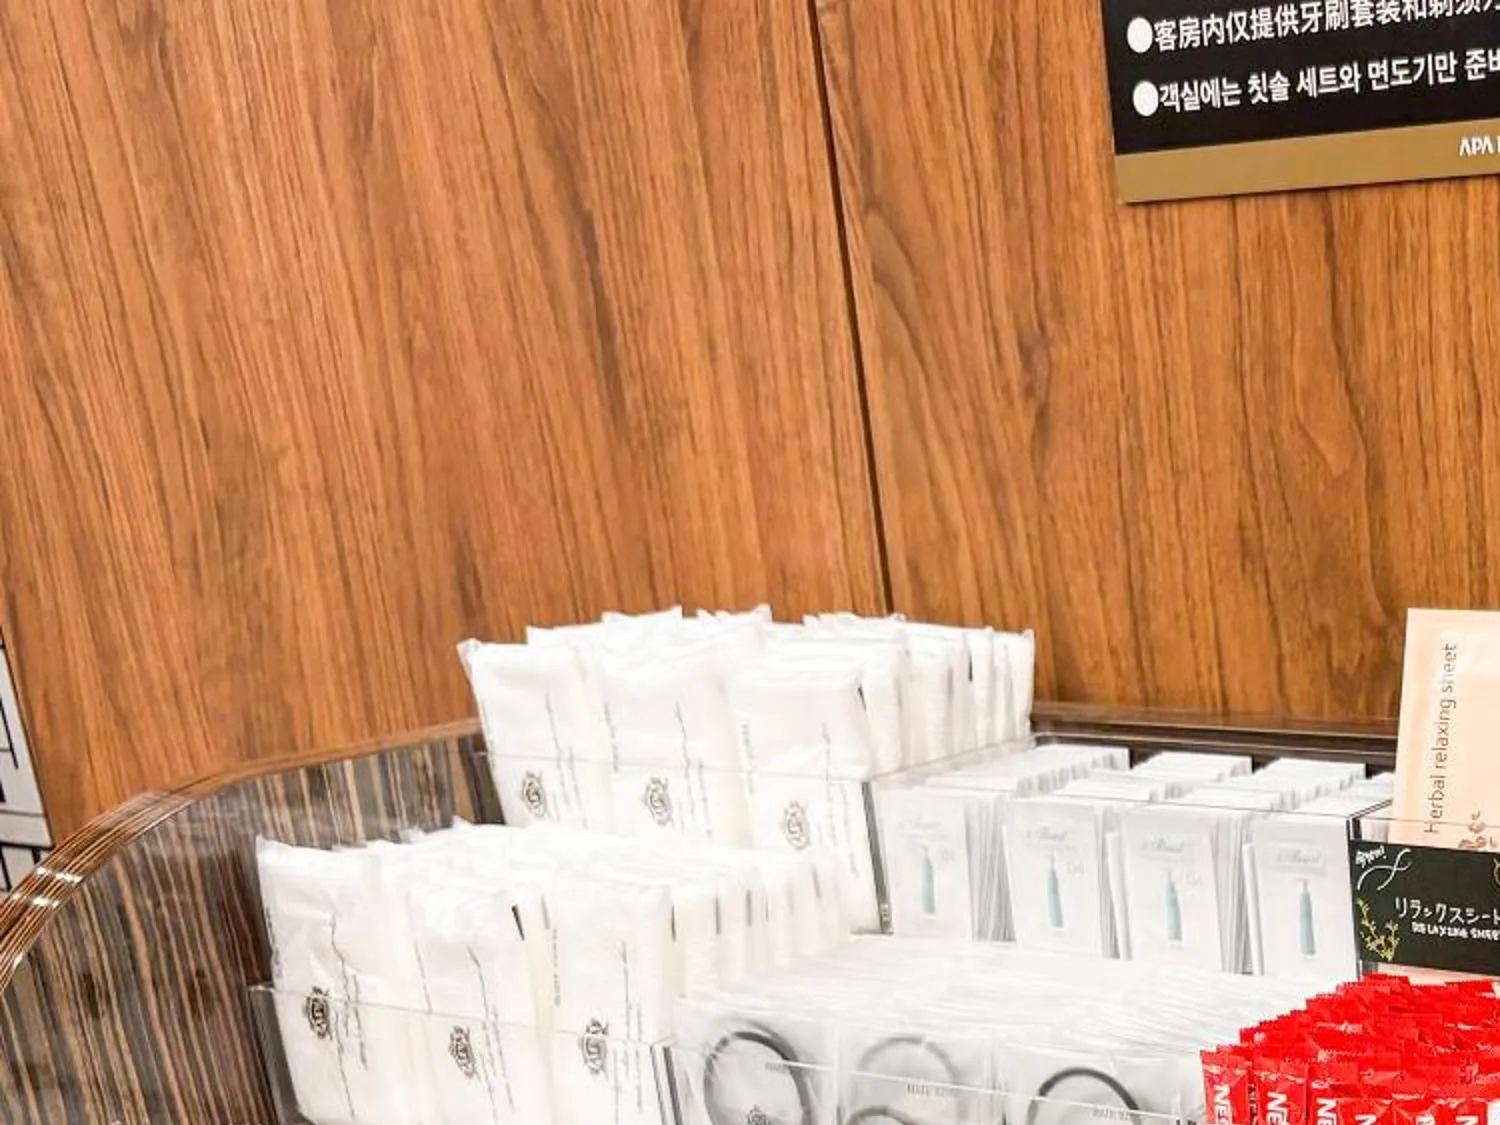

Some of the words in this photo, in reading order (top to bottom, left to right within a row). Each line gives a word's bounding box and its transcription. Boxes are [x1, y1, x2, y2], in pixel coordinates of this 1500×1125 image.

[1160, 77, 1242, 113] 객실에는
[1248, 70, 1290, 104] 칫솔
[1296, 64, 1361, 98] 세트와
[1367, 51, 1457, 91] 면도기만
[1459, 136, 1493, 156] APA
[1442, 643, 1457, 694] sheet
[1432, 699, 1457, 771] relaxing
[1424, 774, 1445, 834] Herbal
